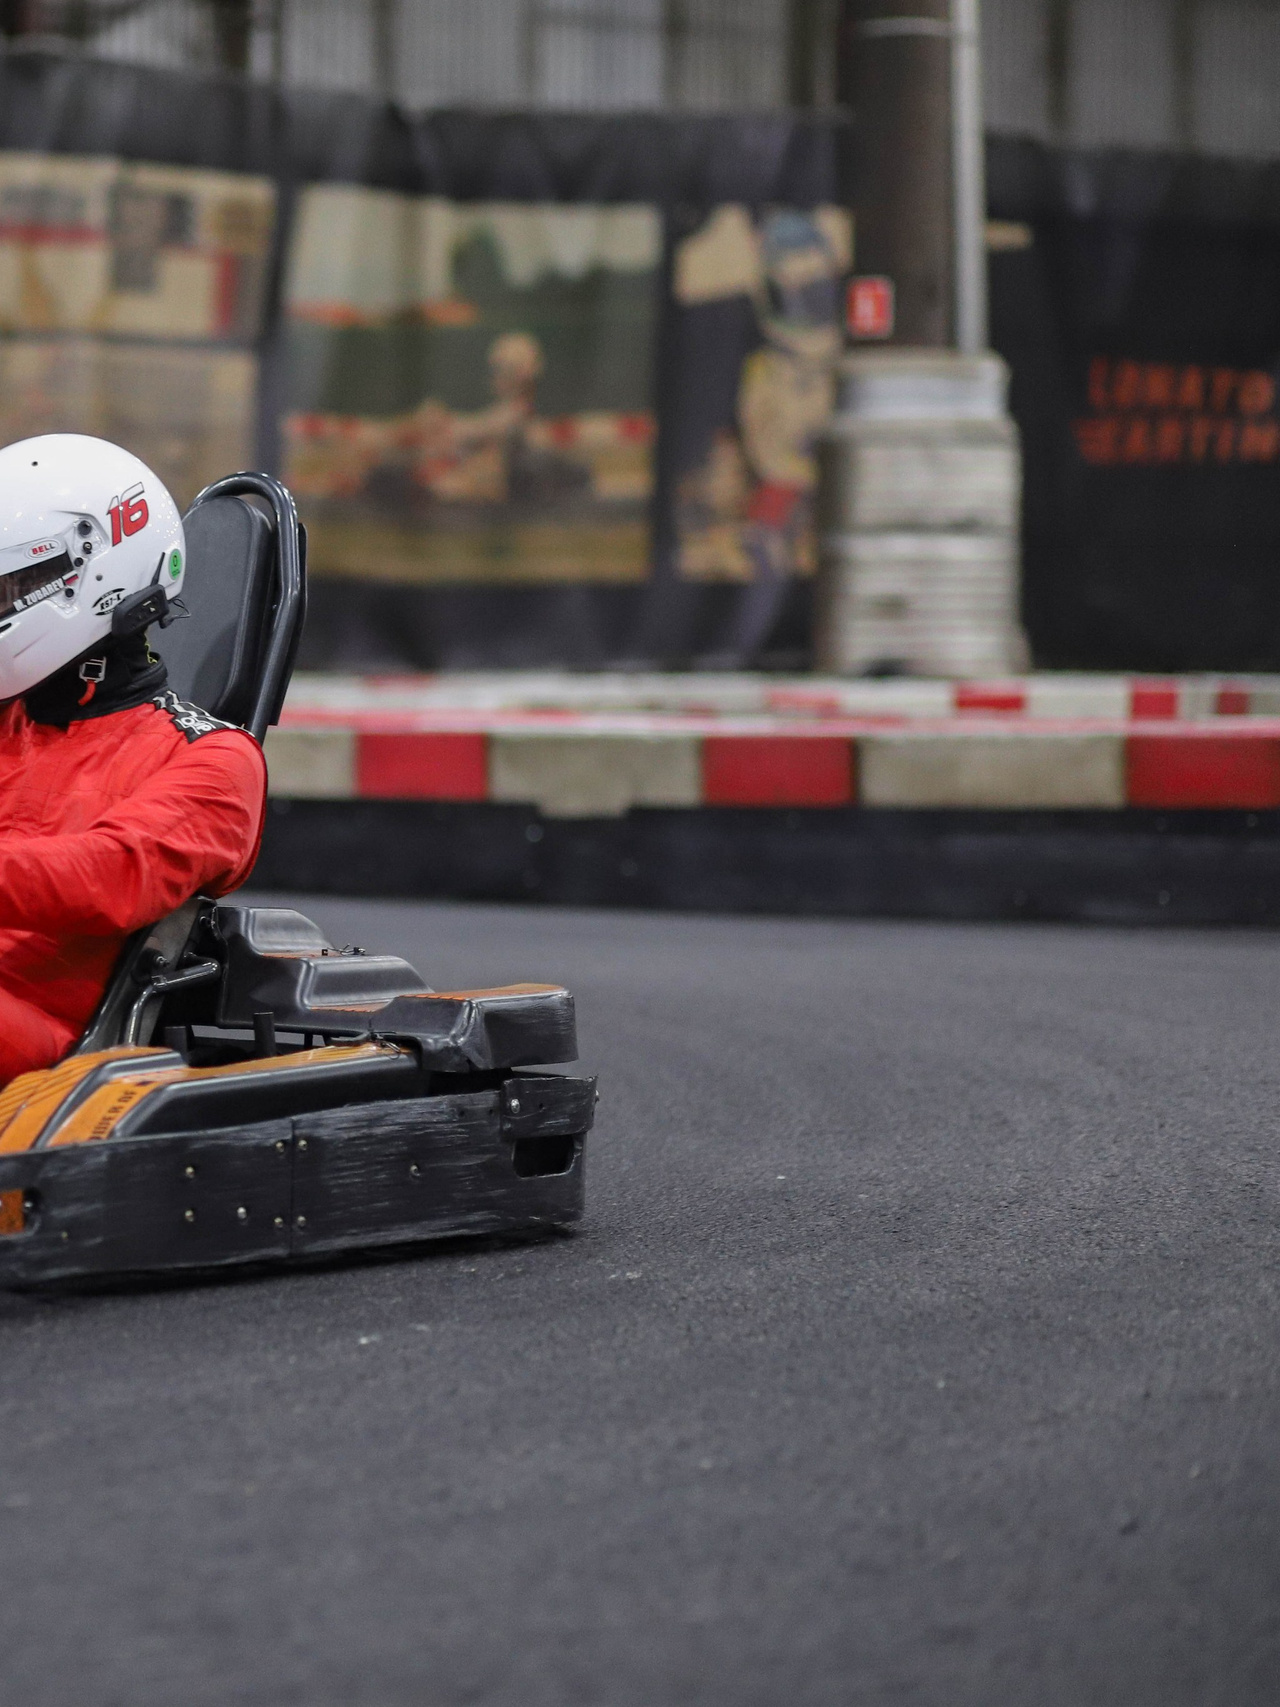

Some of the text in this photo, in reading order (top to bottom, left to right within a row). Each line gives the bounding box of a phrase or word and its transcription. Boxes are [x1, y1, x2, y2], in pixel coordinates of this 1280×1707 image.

[1075, 417, 1280, 465] KARTIN
[106, 481, 150, 548] 16
[31, 542, 56, 555] BELL
[12, 577, 65, 612] M. ZUBAREV
